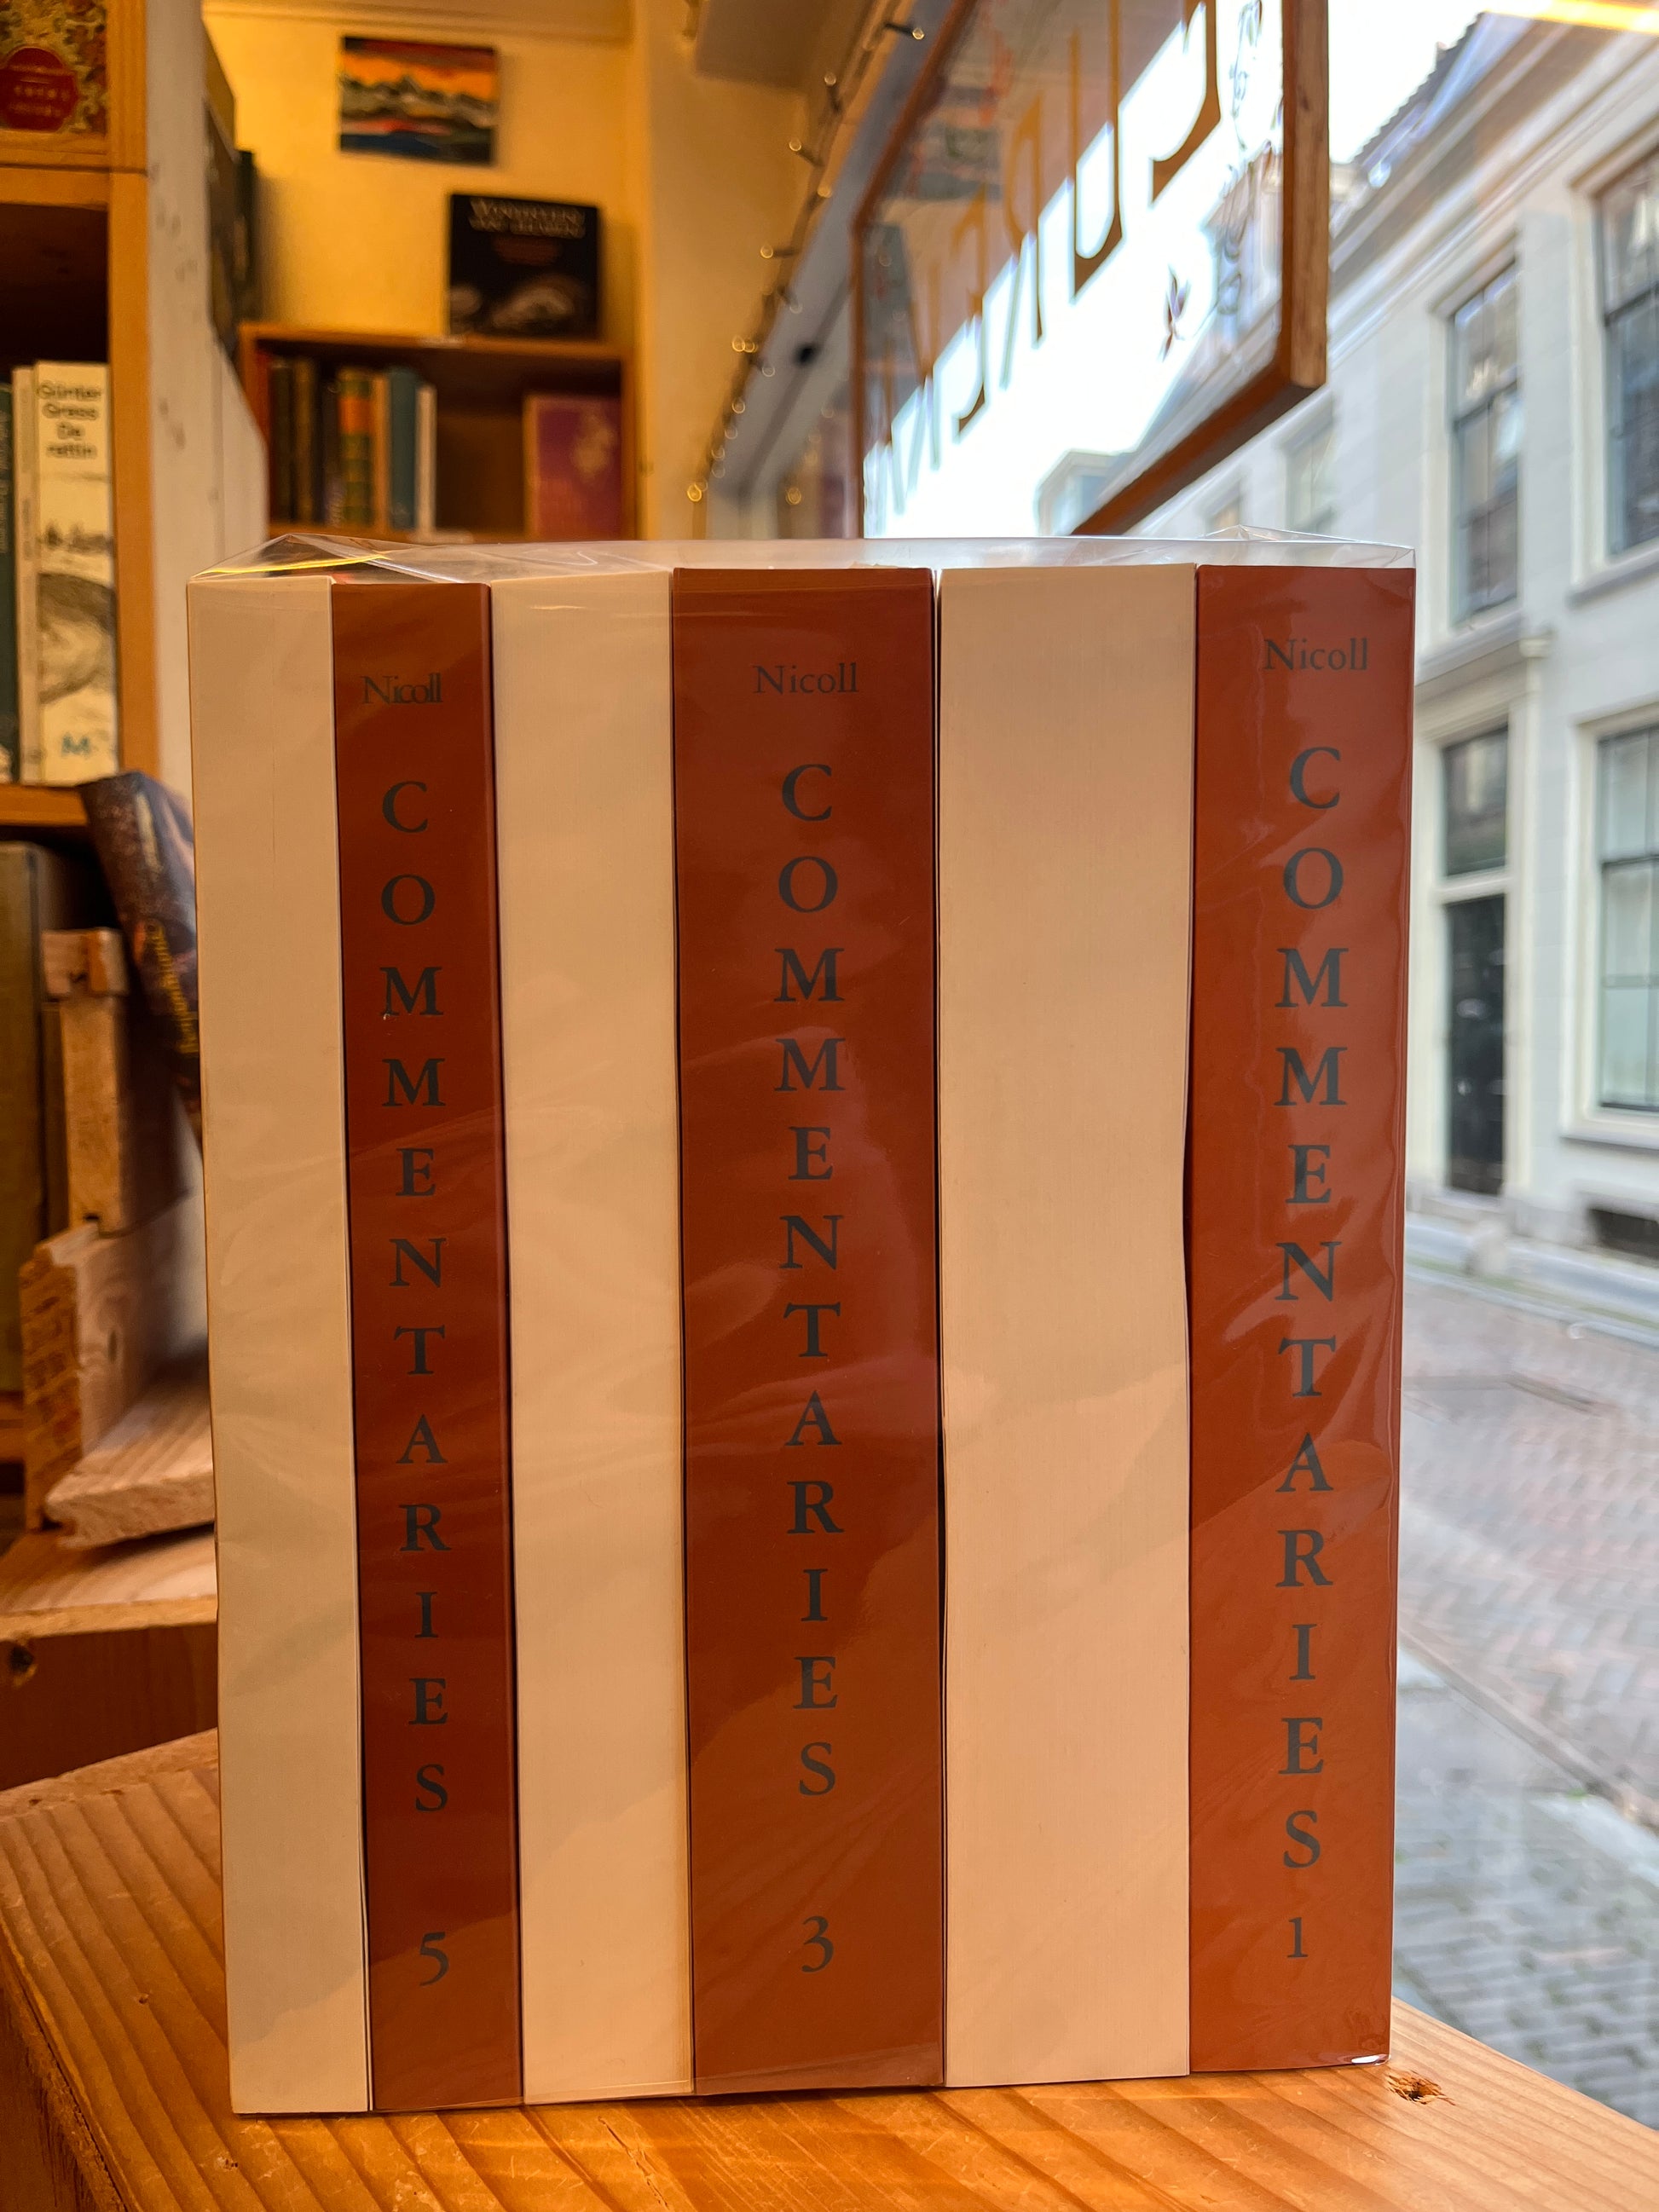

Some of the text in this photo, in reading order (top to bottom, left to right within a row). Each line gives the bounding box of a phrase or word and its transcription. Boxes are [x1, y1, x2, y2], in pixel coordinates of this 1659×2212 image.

[753, 662, 859, 694] Nicoll
[1263, 638, 1368, 670] Nicoll
[361, 673, 442, 705] Nicoll
[380, 782, 451, 1811] COMMENTARIES
[774, 765, 845, 1795] COMMENTARIES
[1275, 748, 1348, 1868] COMMENTARIES
[419, 1932, 449, 1986] 5
[801, 1915, 834, 1972] 3
[1286, 1916, 1309, 1958] 1
